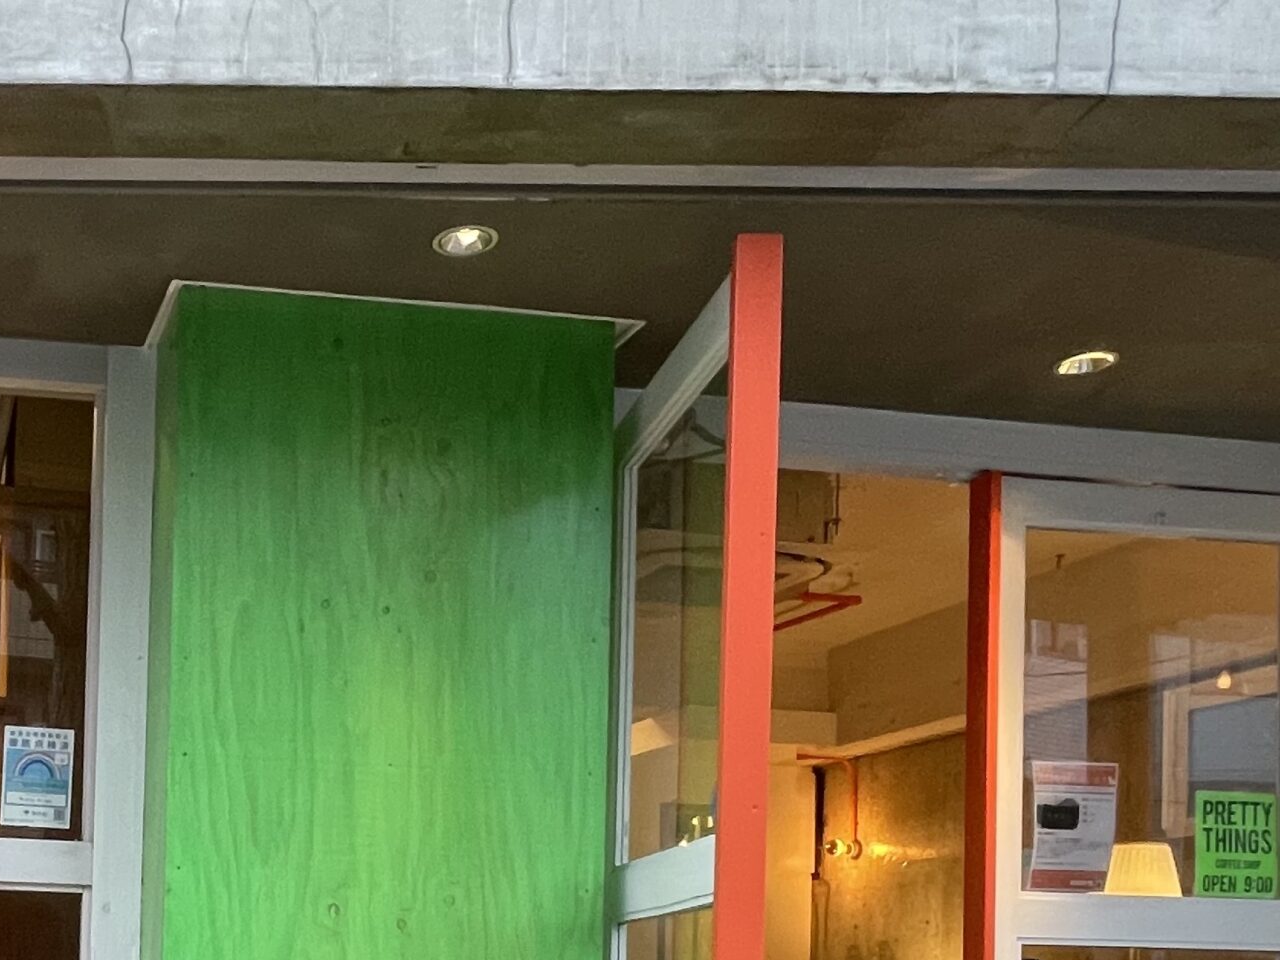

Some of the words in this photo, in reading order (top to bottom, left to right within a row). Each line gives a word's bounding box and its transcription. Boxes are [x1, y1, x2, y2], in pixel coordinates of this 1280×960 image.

[1202, 799, 1273, 827] PRETTY
[1202, 827, 1273, 854] THINGS
[1202, 874, 1237, 893] OPEN
[1243, 876, 1274, 893] 9:00
